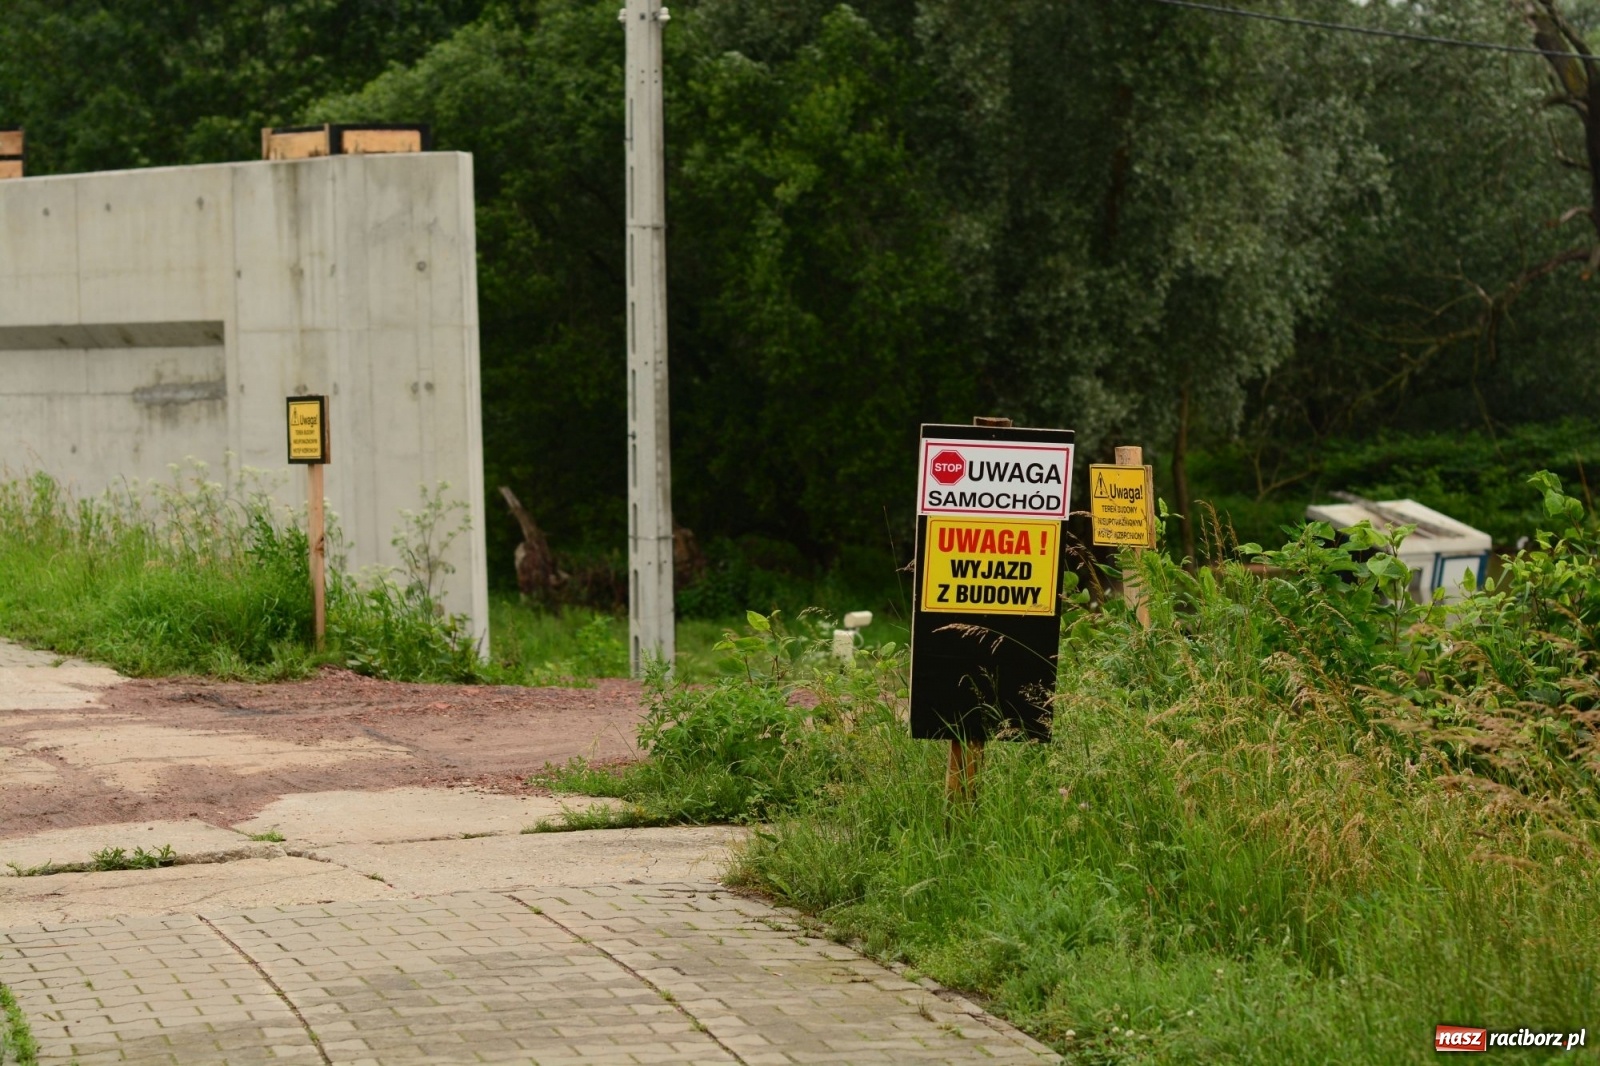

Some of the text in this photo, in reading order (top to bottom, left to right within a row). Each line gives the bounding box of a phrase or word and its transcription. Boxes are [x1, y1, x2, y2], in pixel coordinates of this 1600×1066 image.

[934, 463, 962, 473] STOP
[968, 460, 1062, 485] UWAGA
[928, 490, 1061, 510] SAMOCHÓD
[1110, 484, 1143, 503] Uwaga!
[938, 527, 1047, 556] UWAGA !
[950, 559, 1032, 580] WYJAZD
[937, 583, 1042, 605] Z BUDOWY
